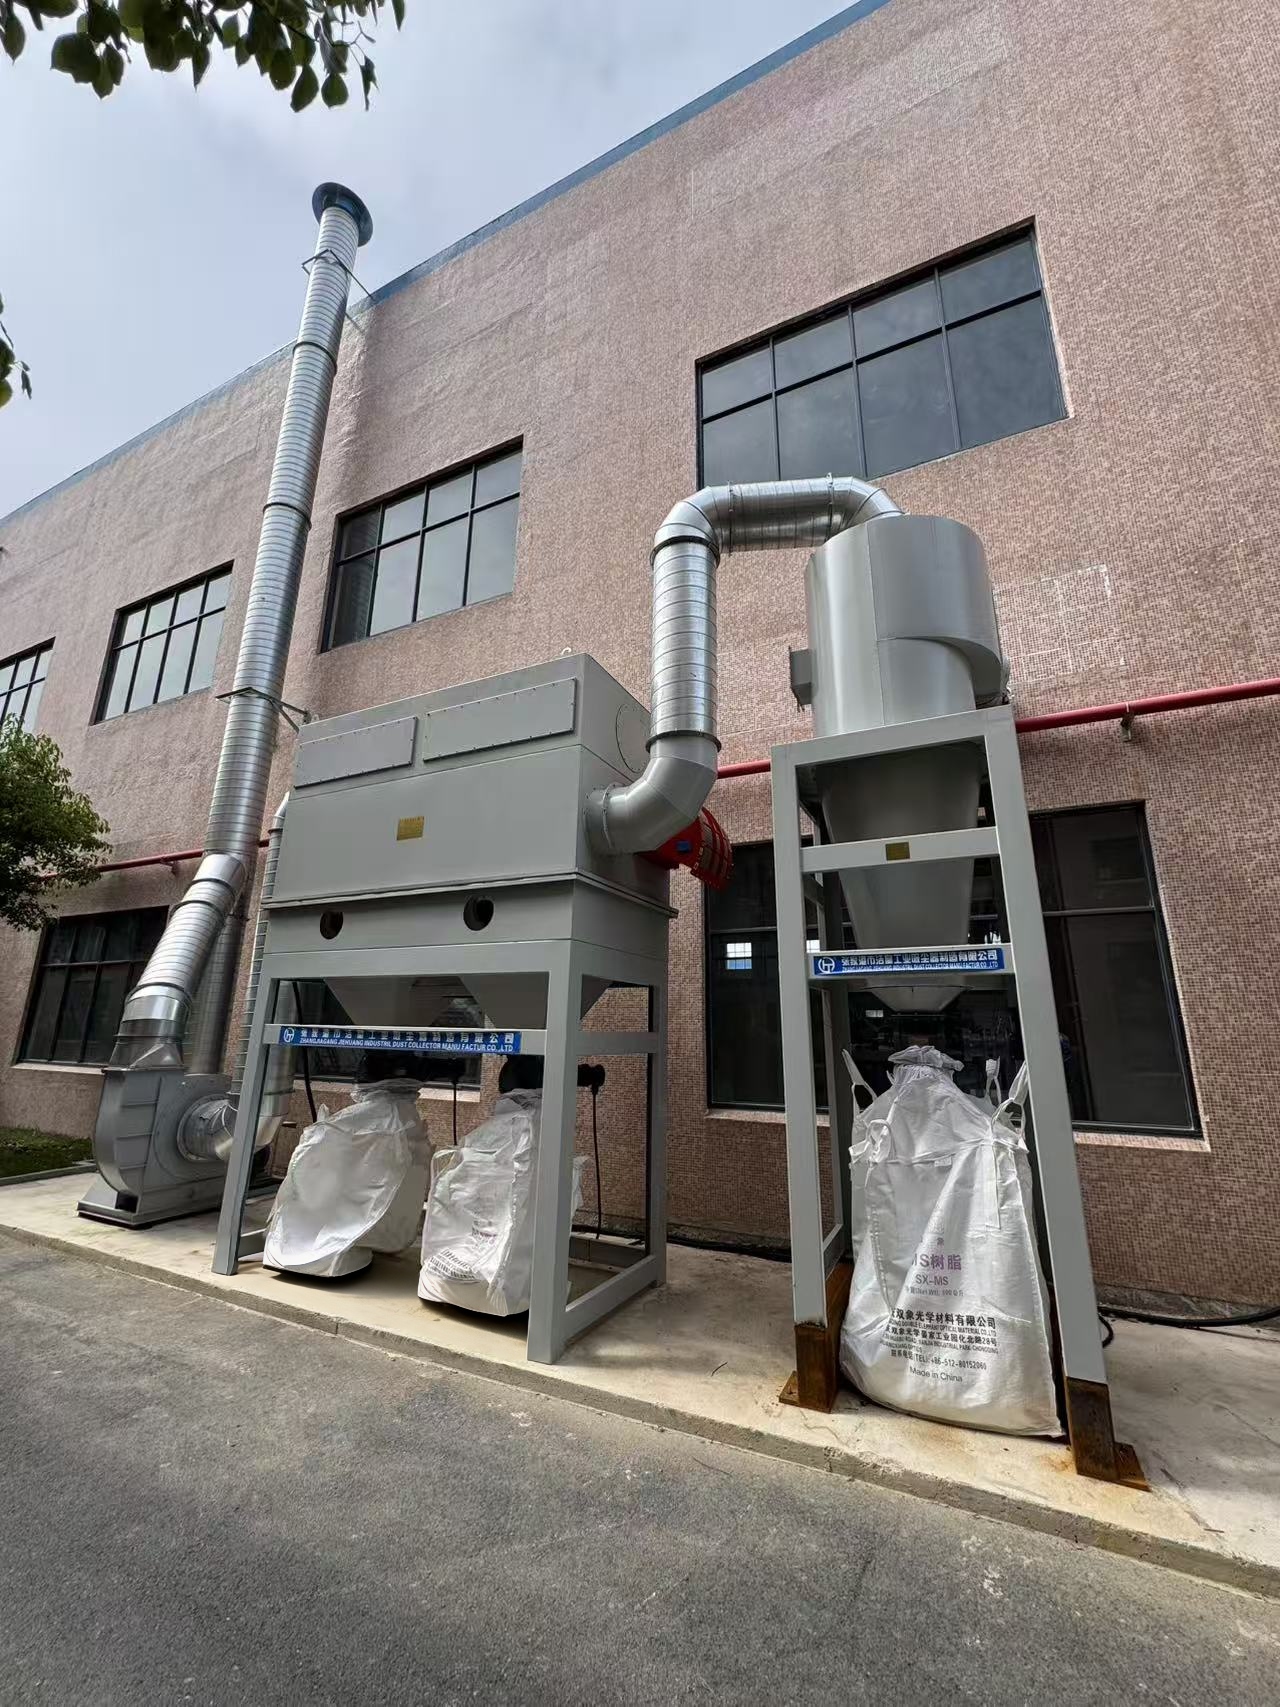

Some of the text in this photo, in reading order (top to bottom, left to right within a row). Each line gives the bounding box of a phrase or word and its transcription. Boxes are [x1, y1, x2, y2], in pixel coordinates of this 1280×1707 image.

[408, 1041, 440, 1049] COLLECTOR
[915, 1274, 949, 1286] SX-MS
[909, 1366, 963, 1382] Made in China
